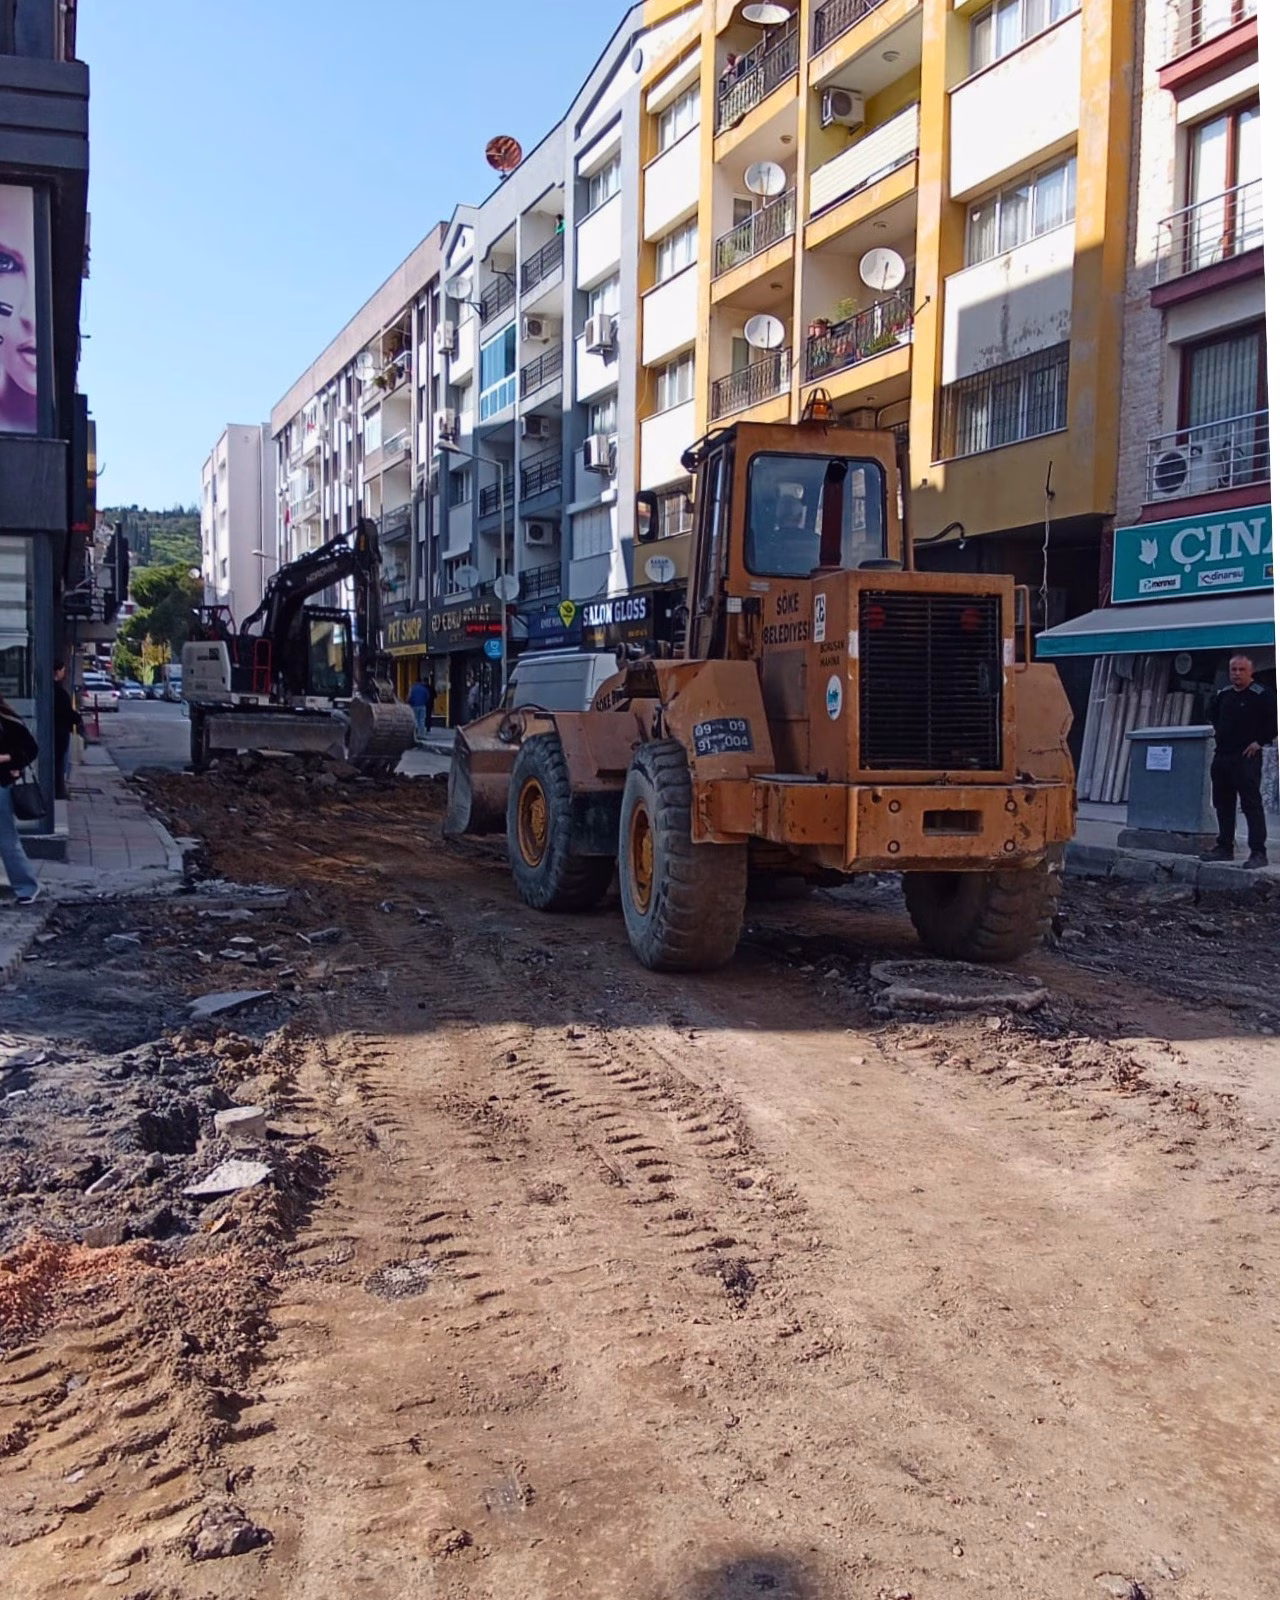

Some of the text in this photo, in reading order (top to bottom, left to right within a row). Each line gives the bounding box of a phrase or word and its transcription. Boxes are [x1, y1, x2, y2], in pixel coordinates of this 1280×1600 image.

[1170, 517, 1273, 573] ÇIN
[583, 602, 613, 627] SALON
[614, 597, 646, 622] GLOSS
[776, 589, 799, 616] SÖKE
[388, 620, 400, 644] PET
[401, 617, 422, 641] SHOP
[695, 720, 746, 737] 09 09
[725, 735, 748, 747] 004
